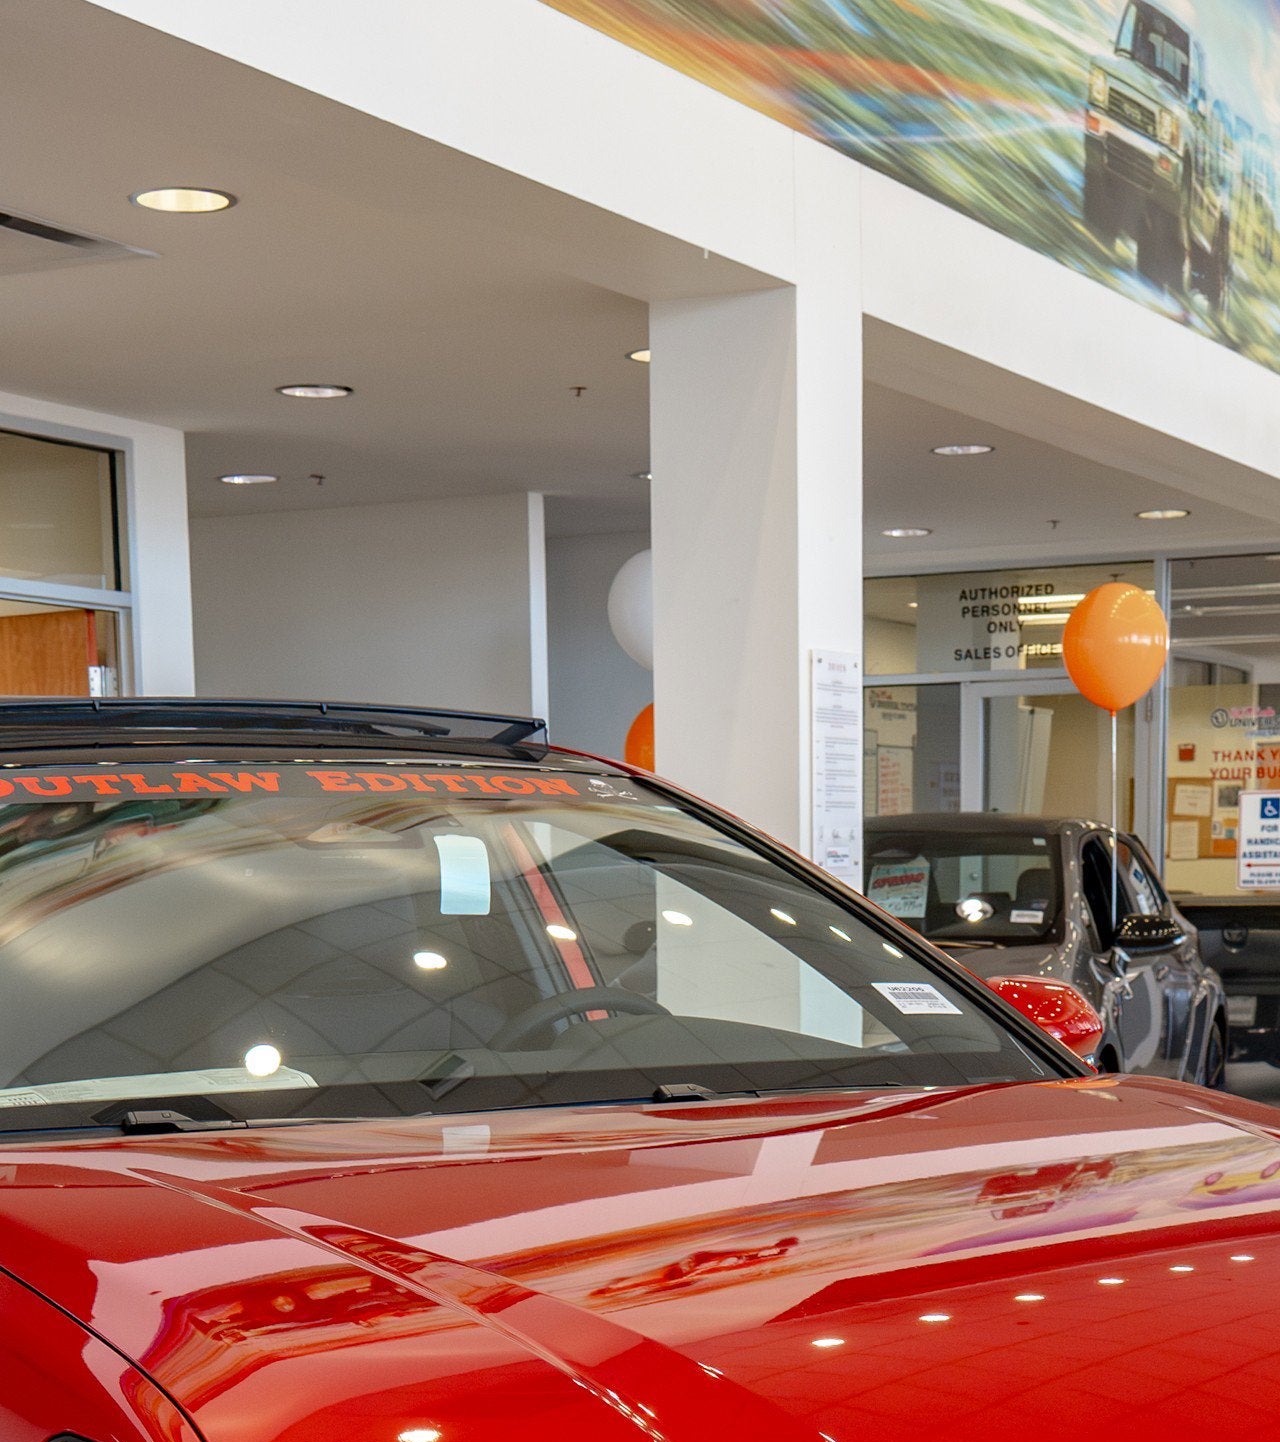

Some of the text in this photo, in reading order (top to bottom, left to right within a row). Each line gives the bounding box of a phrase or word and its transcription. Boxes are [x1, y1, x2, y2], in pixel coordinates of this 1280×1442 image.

[959, 584, 1054, 600] AUTHORIZED
[961, 602, 1052, 618] PERSONNEL
[986, 621, 1024, 634] ONLY
[954, 646, 1001, 661] SALES
[1213, 749, 1265, 763] THANK
[1209, 767, 1252, 780] YOUR
[307, 770, 579, 796] EDITION
[1260, 824, 1279, 833] FOR
